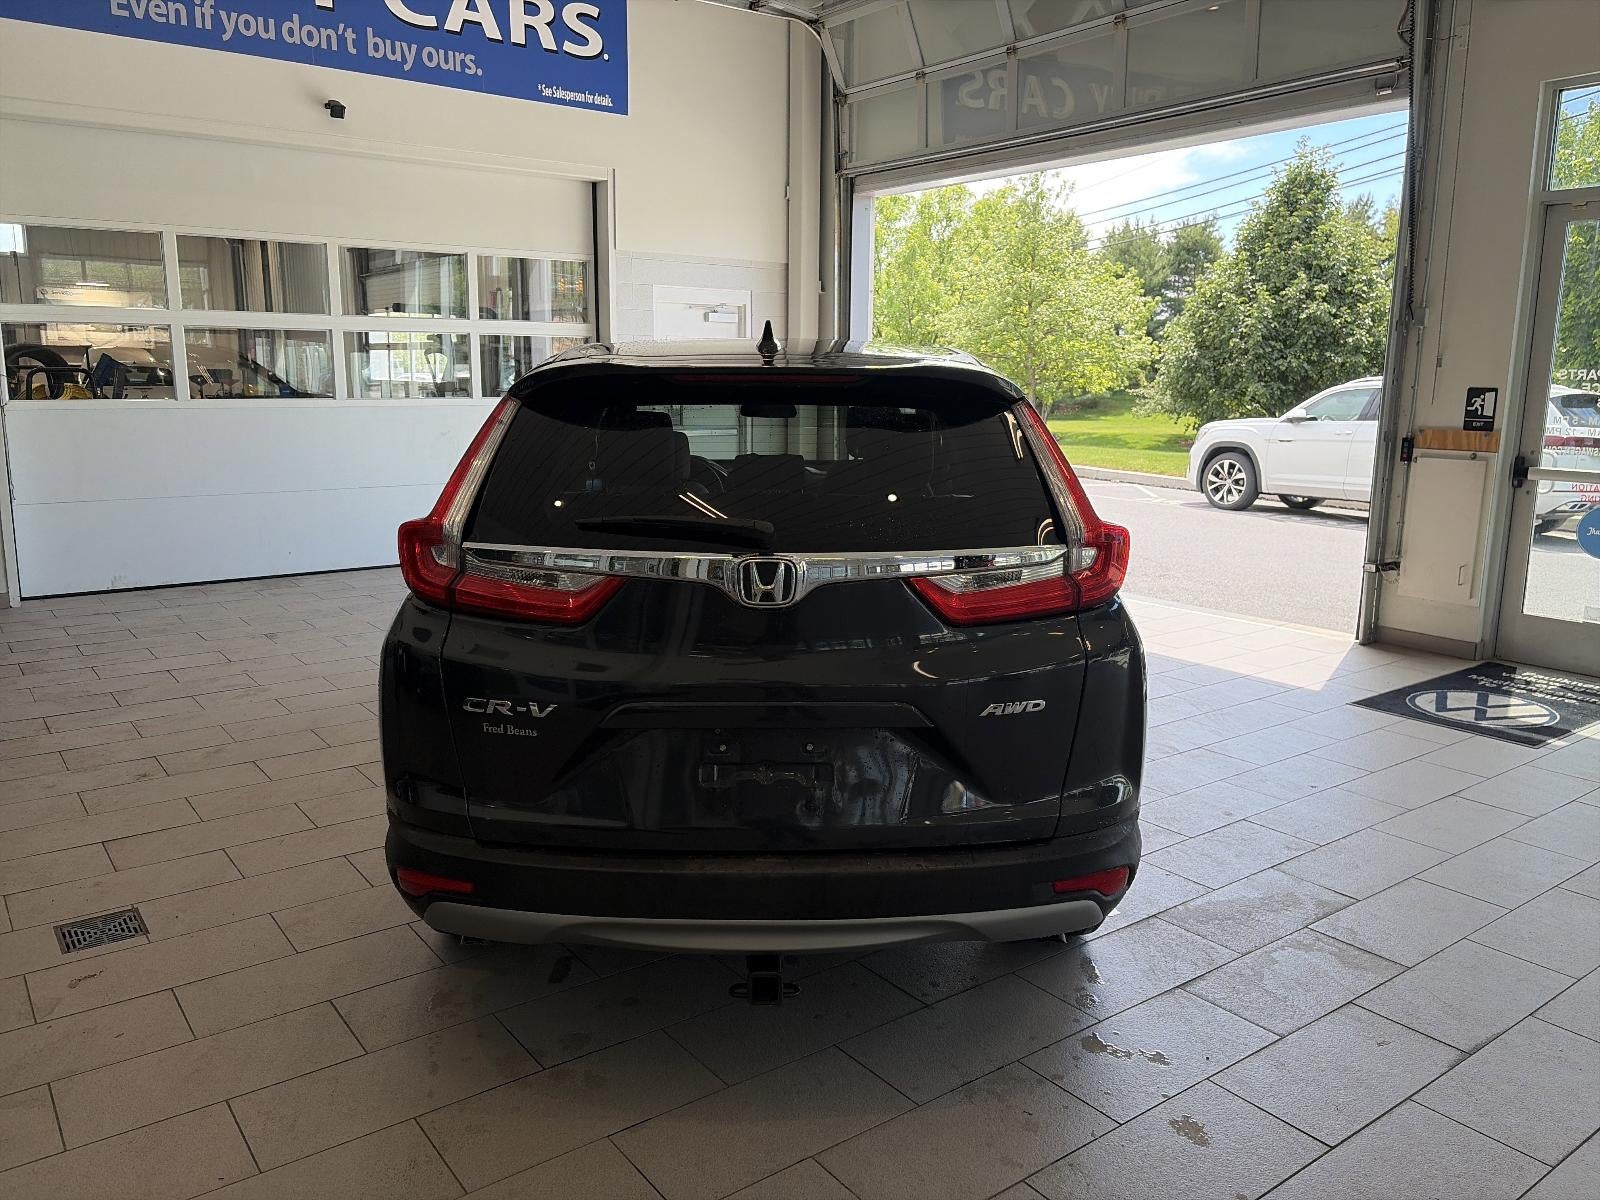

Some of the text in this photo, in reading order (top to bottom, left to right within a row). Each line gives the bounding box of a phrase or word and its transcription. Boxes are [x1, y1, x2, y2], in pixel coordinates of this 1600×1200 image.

[110, 0, 484, 76] Even if you don't buy ours.
[552, 86, 586, 102] Salesperson
[585, 90, 594, 104] for
[593, 92, 614, 107] details.
[462, 697, 558, 718] CR-V
[979, 699, 1046, 717] AWD
[482, 722, 538, 737] Fred Beans
